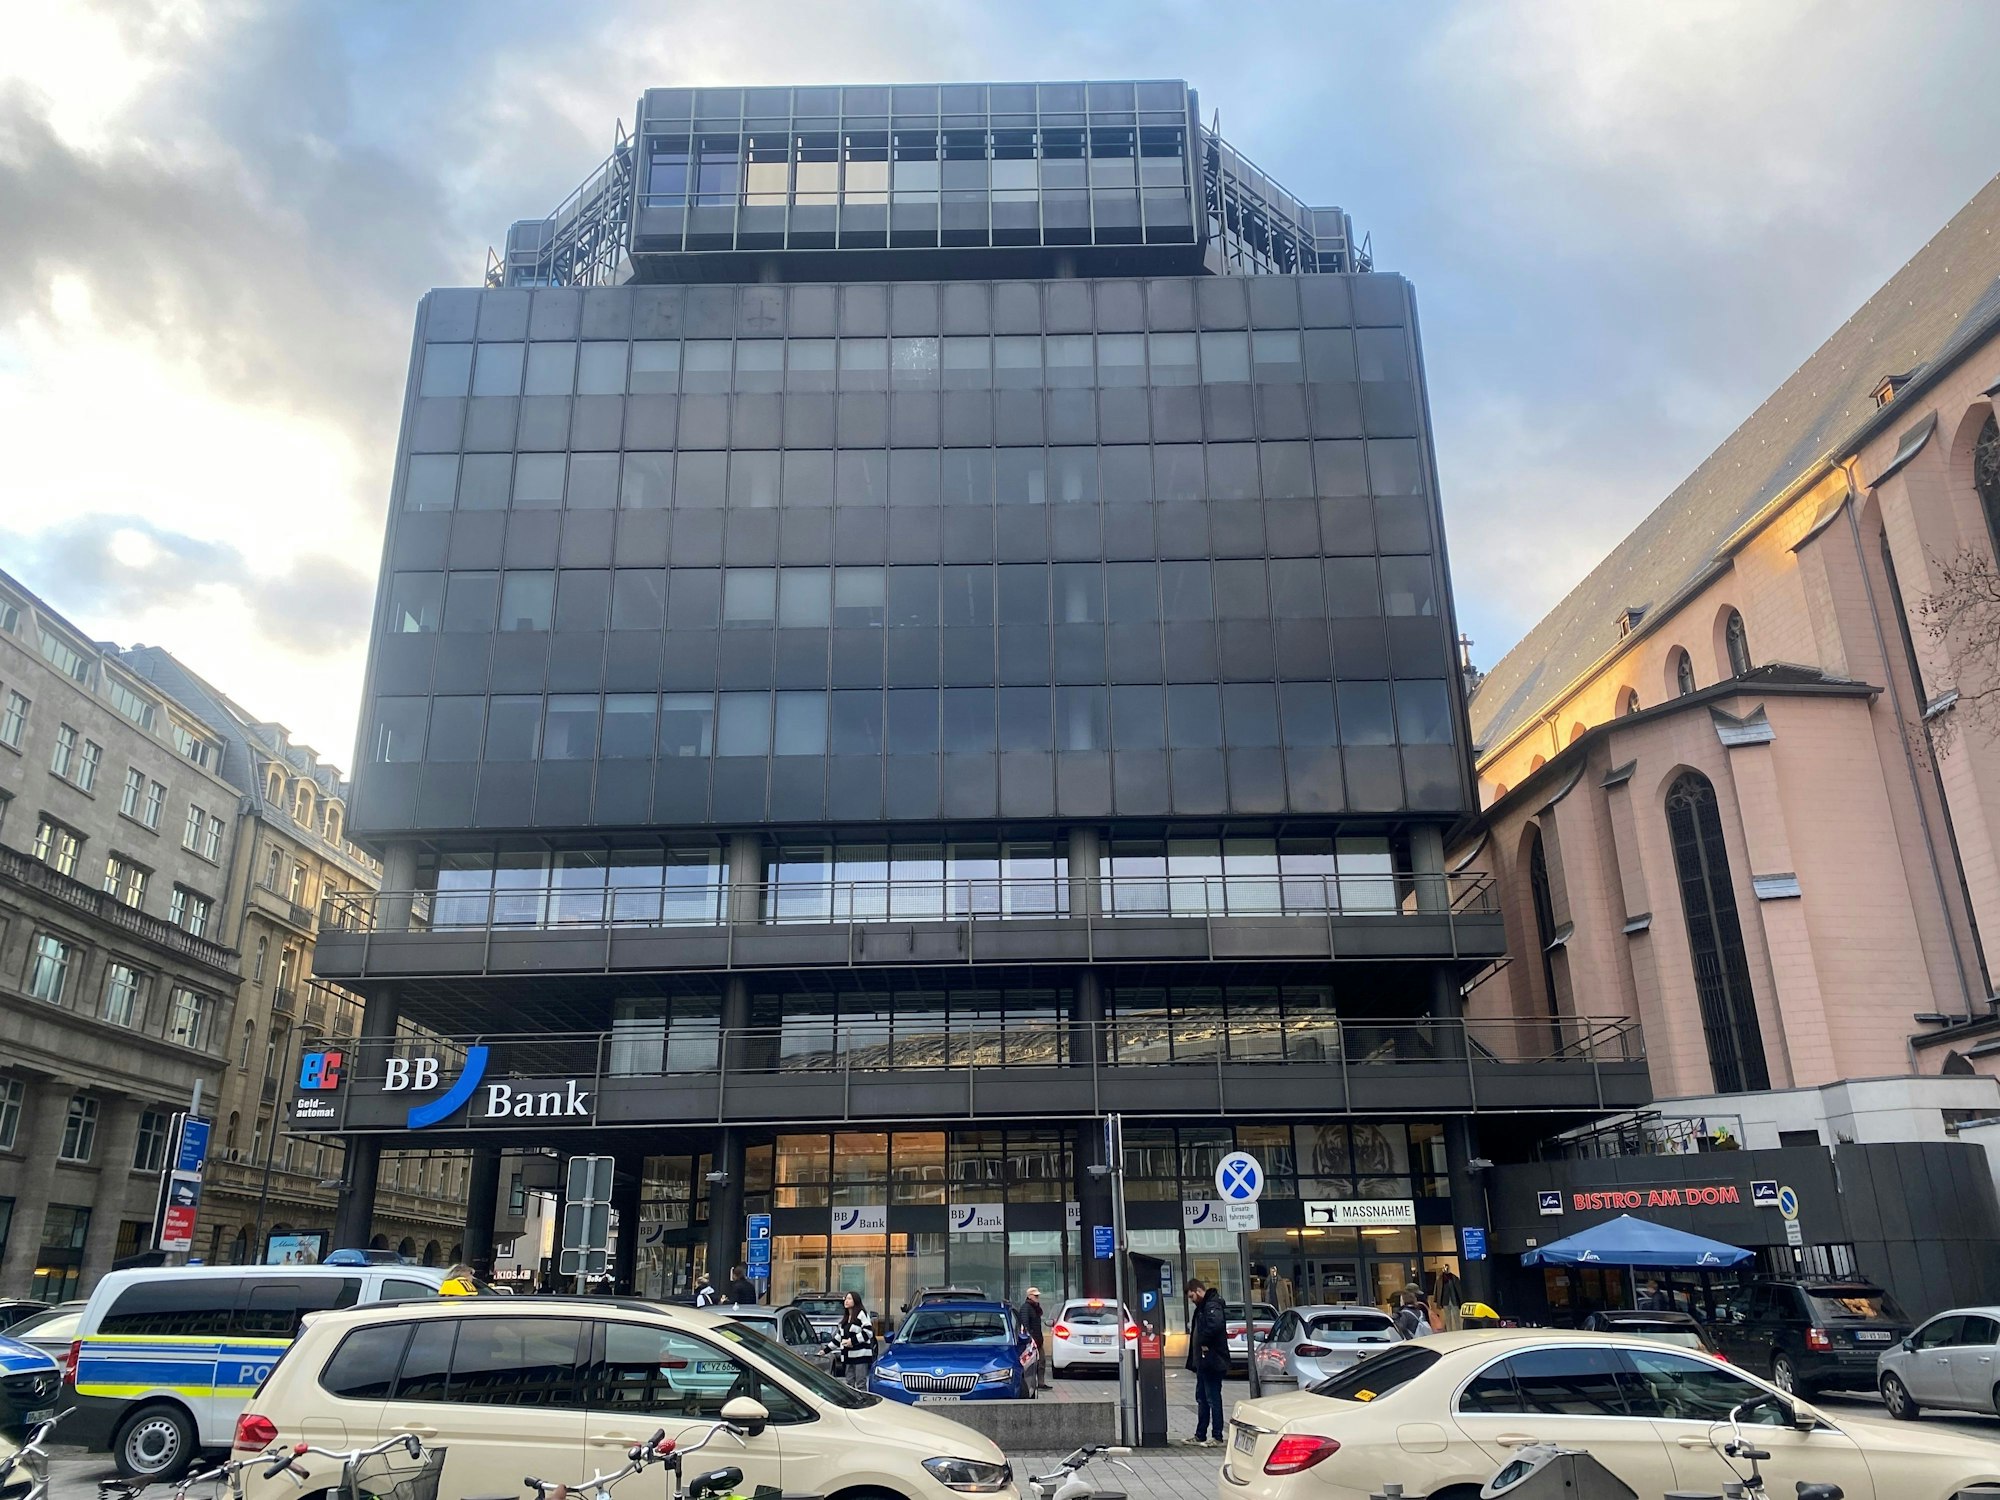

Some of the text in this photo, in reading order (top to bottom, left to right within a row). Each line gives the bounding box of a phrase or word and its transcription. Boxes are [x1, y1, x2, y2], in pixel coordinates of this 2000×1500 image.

[381, 1057, 440, 1091] BB
[484, 1079, 590, 1118] Bank
[297, 1099, 326, 1109] Geld-
[296, 1108, 335, 1118] automat
[1573, 1186, 1740, 1211] BISTRO AM DOM
[951, 1210, 965, 1219] BB
[1185, 1206, 1199, 1216] BB
[1342, 1205, 1411, 1218] MASSNAHME
[834, 1212, 848, 1221] BB
[977, 1216, 1002, 1226] Bank
[1211, 1213, 1225, 1223] Ba
[859, 1218, 885, 1228] Bank
[640, 1227, 653, 1235] BB
[760, 1227, 768, 1239] P
[1143, 1293, 1153, 1309] P
[1462, 1304, 1476, 1315] TAXI
